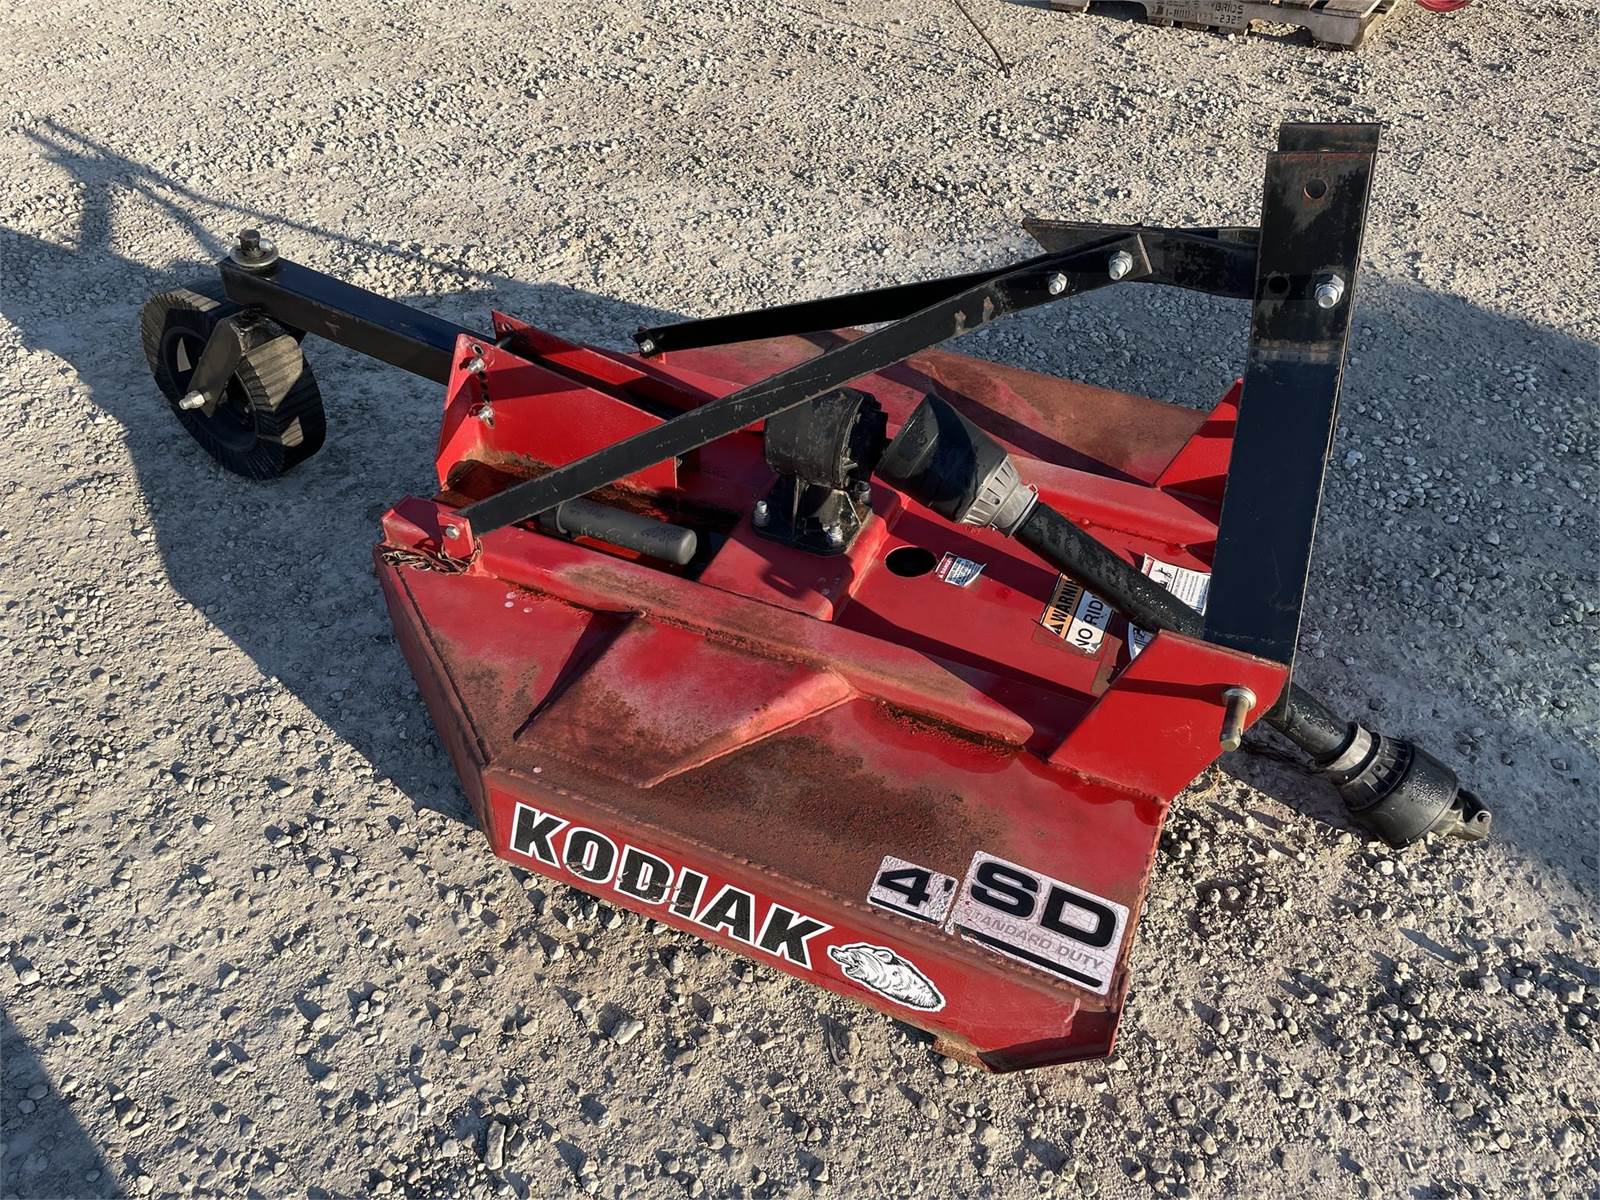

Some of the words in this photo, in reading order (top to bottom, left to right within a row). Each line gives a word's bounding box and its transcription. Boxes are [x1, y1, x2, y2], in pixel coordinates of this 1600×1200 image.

[1074, 628, 1093, 651] NO
[1083, 595, 1104, 625] RID
[509, 802, 834, 970] KODIAK
[970, 861, 1118, 948] SD
[964, 909, 1053, 950] STANDARD
[1057, 945, 1105, 970] DUTY
